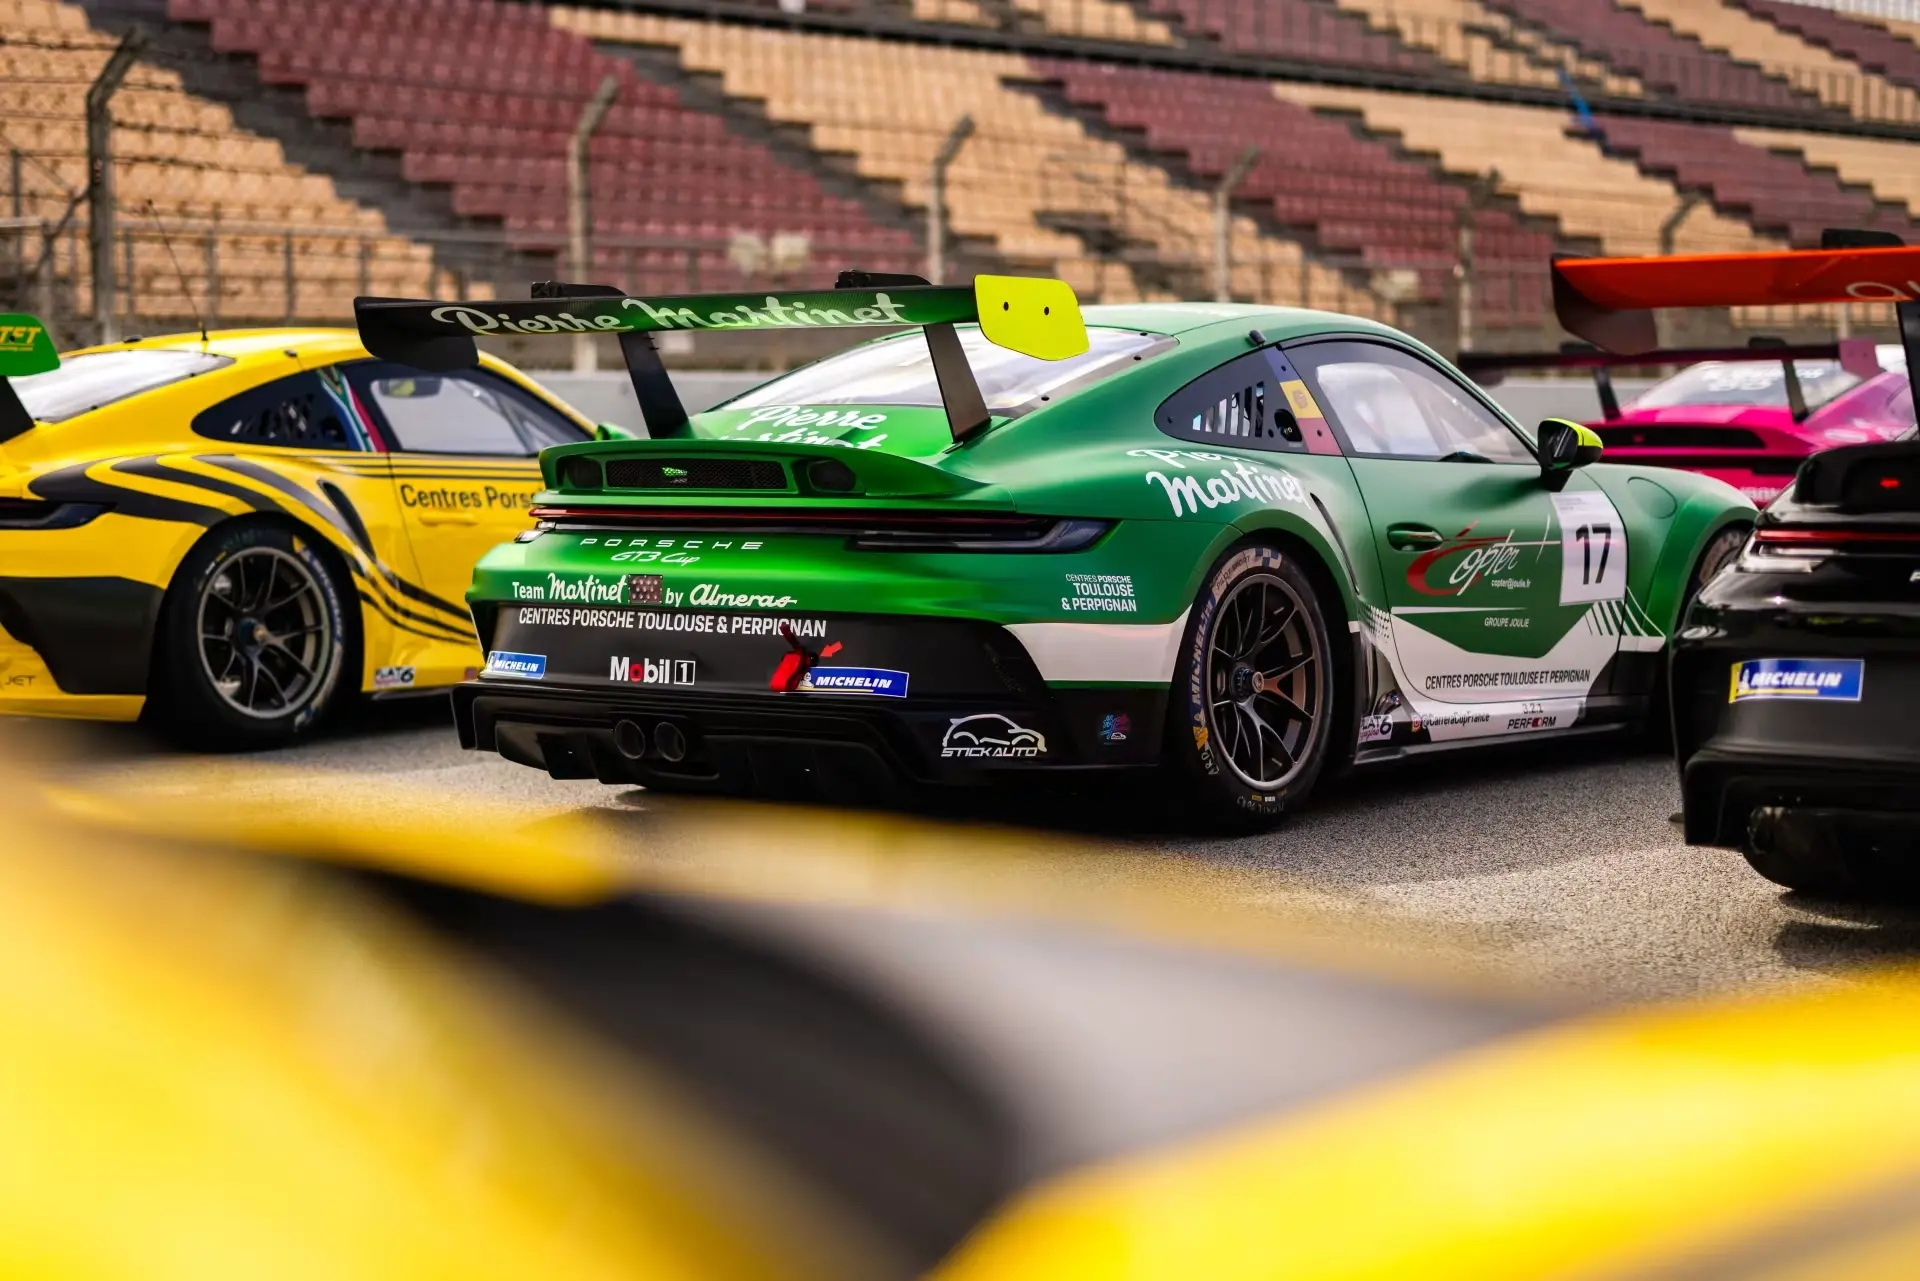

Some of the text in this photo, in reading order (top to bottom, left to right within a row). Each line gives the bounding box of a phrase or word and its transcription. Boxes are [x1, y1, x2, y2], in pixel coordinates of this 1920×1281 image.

[431, 293, 920, 336] Pierre Martinet
[736, 405, 887, 431] Pierre
[400, 484, 482, 508] Centres
[1145, 461, 1311, 518] Martinet
[580, 538, 764, 550] PORSCHE
[610, 550, 701, 567] GT3 Cup
[1576, 523, 1611, 585] 17
[1065, 573, 1132, 584] CENTRES PORSCHE
[512, 573, 798, 608] Team Martinet by Almeras
[1072, 582, 1135, 597] TOULOUSE
[1061, 597, 1137, 612] & PERPIGNAN
[518, 607, 571, 626] CENTRES
[572, 610, 634, 629] PORSCHE
[638, 612, 714, 634] TOULOUSE
[716, 616, 729, 635] &
[1484, 617, 1530, 628] GROUPE JOULIE
[1190, 600, 1213, 705] MICHELIN
[493, 659, 540, 672] MICHELIN
[609, 656, 671, 685] Mobil
[815, 676, 893, 689] MICHELIN
[1425, 668, 1591, 690] CENTRES PORSCHE TOULOUSE ET PERPIGNAN
[1750, 671, 1843, 688] MICHELIN
[1522, 702, 1545, 715] 3.2.1
[1507, 715, 1557, 731] PERFORM
